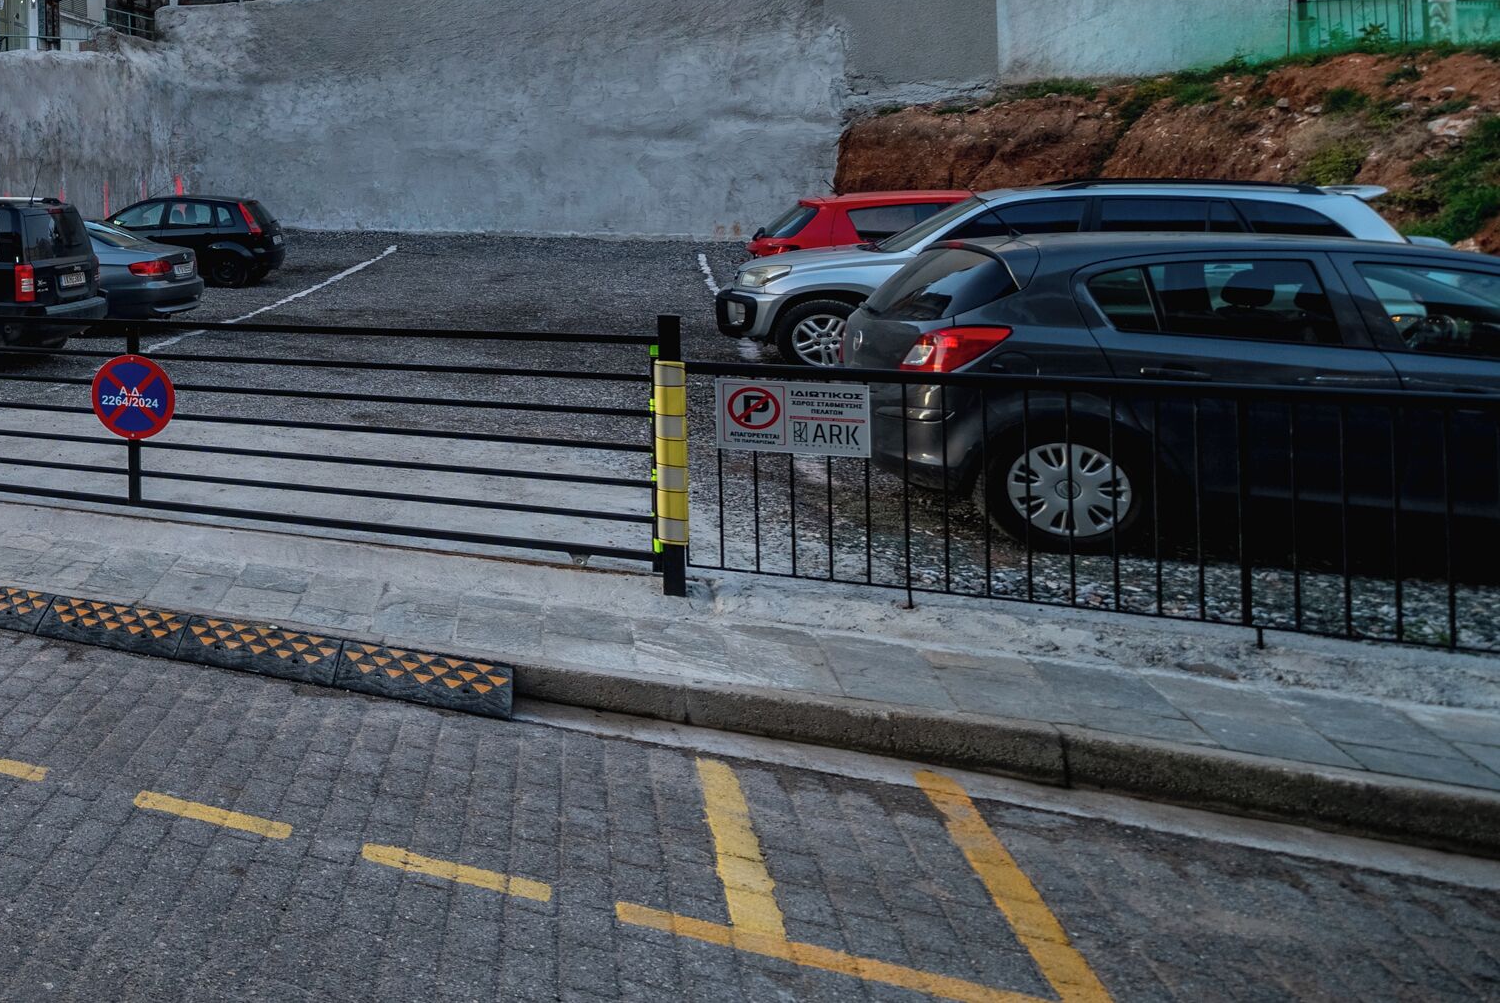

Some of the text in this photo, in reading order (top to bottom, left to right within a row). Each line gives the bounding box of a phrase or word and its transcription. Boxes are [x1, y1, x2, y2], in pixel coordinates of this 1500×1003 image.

[790, 390, 864, 400] ΙΔΙΩΤΙΚΟΣ
[101, 395, 159, 408] 2264/2024
[730, 431, 780, 439] ΑΠΑΓΟΡΕΥΕΤΑΙ
[812, 423, 860, 446] ARK
